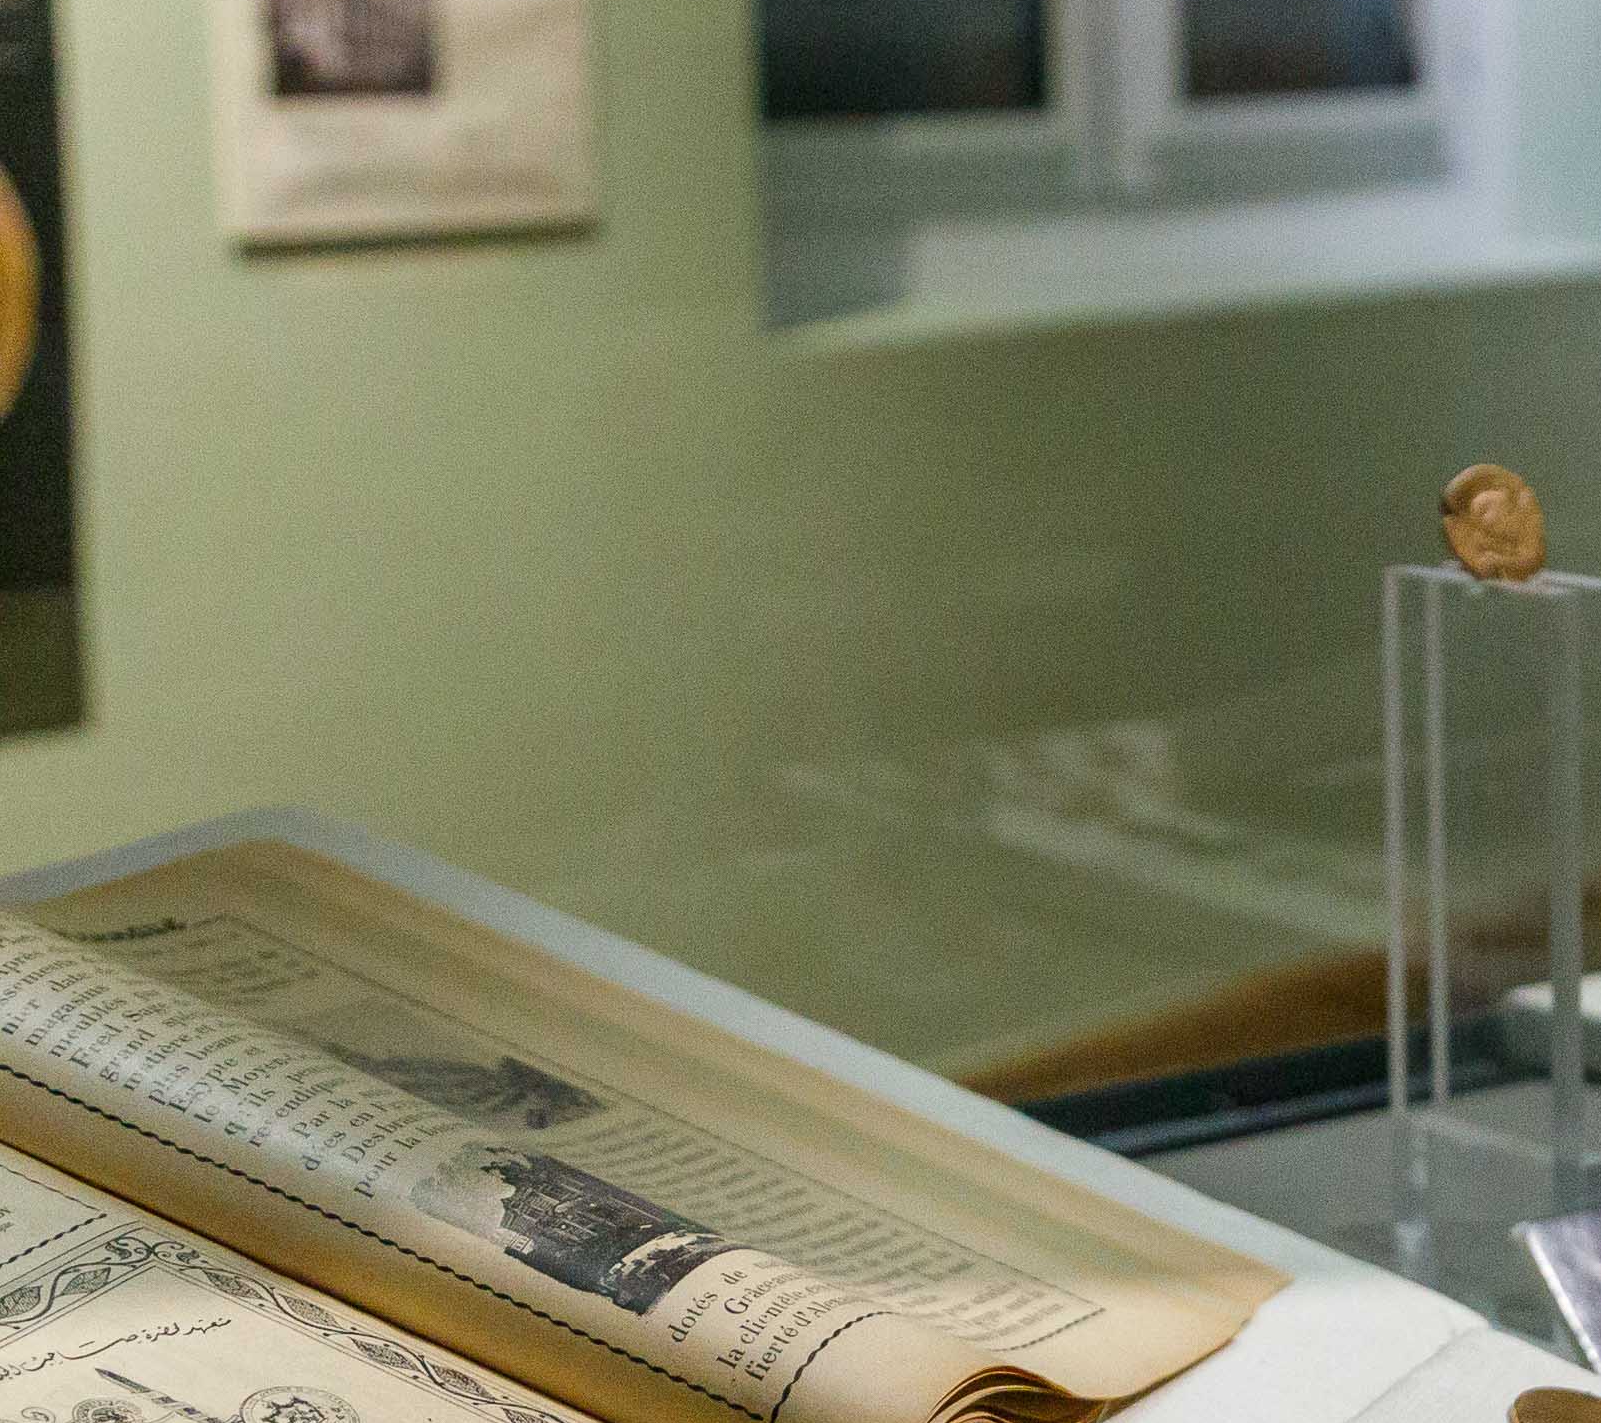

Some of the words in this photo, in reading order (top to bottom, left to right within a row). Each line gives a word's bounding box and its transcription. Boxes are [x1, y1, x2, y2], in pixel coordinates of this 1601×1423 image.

[100, 1027, 157, 1084] grand
[292, 1110, 331, 1139] Par
[353, 1151, 399, 1200] pour
[667, 1290, 720, 1344] dotés
[719, 1268, 749, 1286] de
[715, 1347, 747, 1370] la
[743, 1324, 800, 1381] fierté
